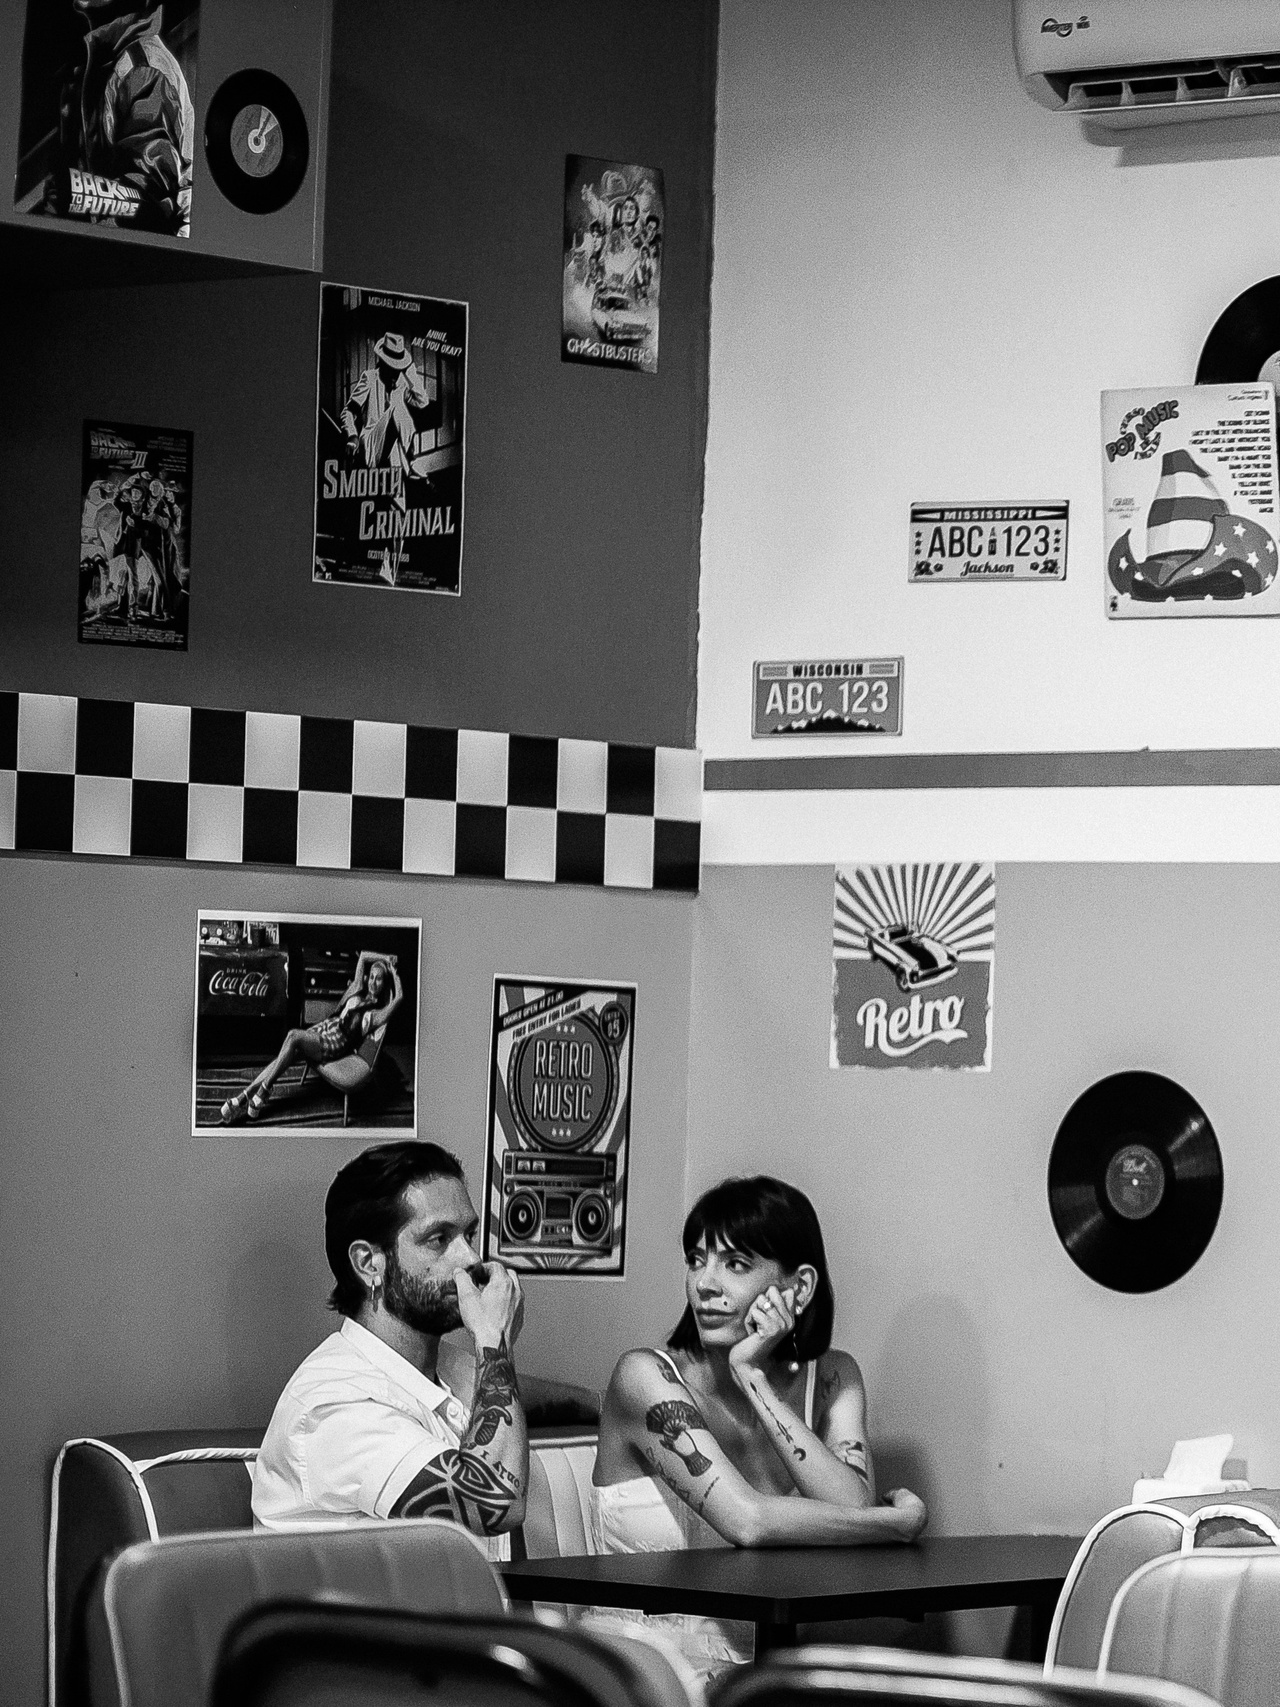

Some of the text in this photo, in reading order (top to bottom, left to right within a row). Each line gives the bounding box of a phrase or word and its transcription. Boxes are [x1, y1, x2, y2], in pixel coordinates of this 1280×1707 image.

[69, 167, 134, 200] BACK
[71, 193, 83, 204] TO
[82, 195, 140, 217] FUTURE
[367, 296, 421, 312] MICHAEL JACKSON
[426, 340, 440, 352] YOU
[1134, 399, 1180, 441] MUSIC
[1105, 431, 1137, 463] POP
[322, 459, 403, 499] SMOOTH
[358, 500, 455, 541] CRIMINAL
[943, 509, 1033, 521] MISSISSIPPI
[927, 524, 1051, 558] ABC 123
[960, 560, 1015, 577] Jackson
[792, 663, 864, 678] WISCONSIN
[765, 680, 889, 715] ABC 123
[856, 994, 968, 1057] Retro
[533, 1040, 594, 1080] RETRO
[532, 1081, 593, 1121] MUSIC
